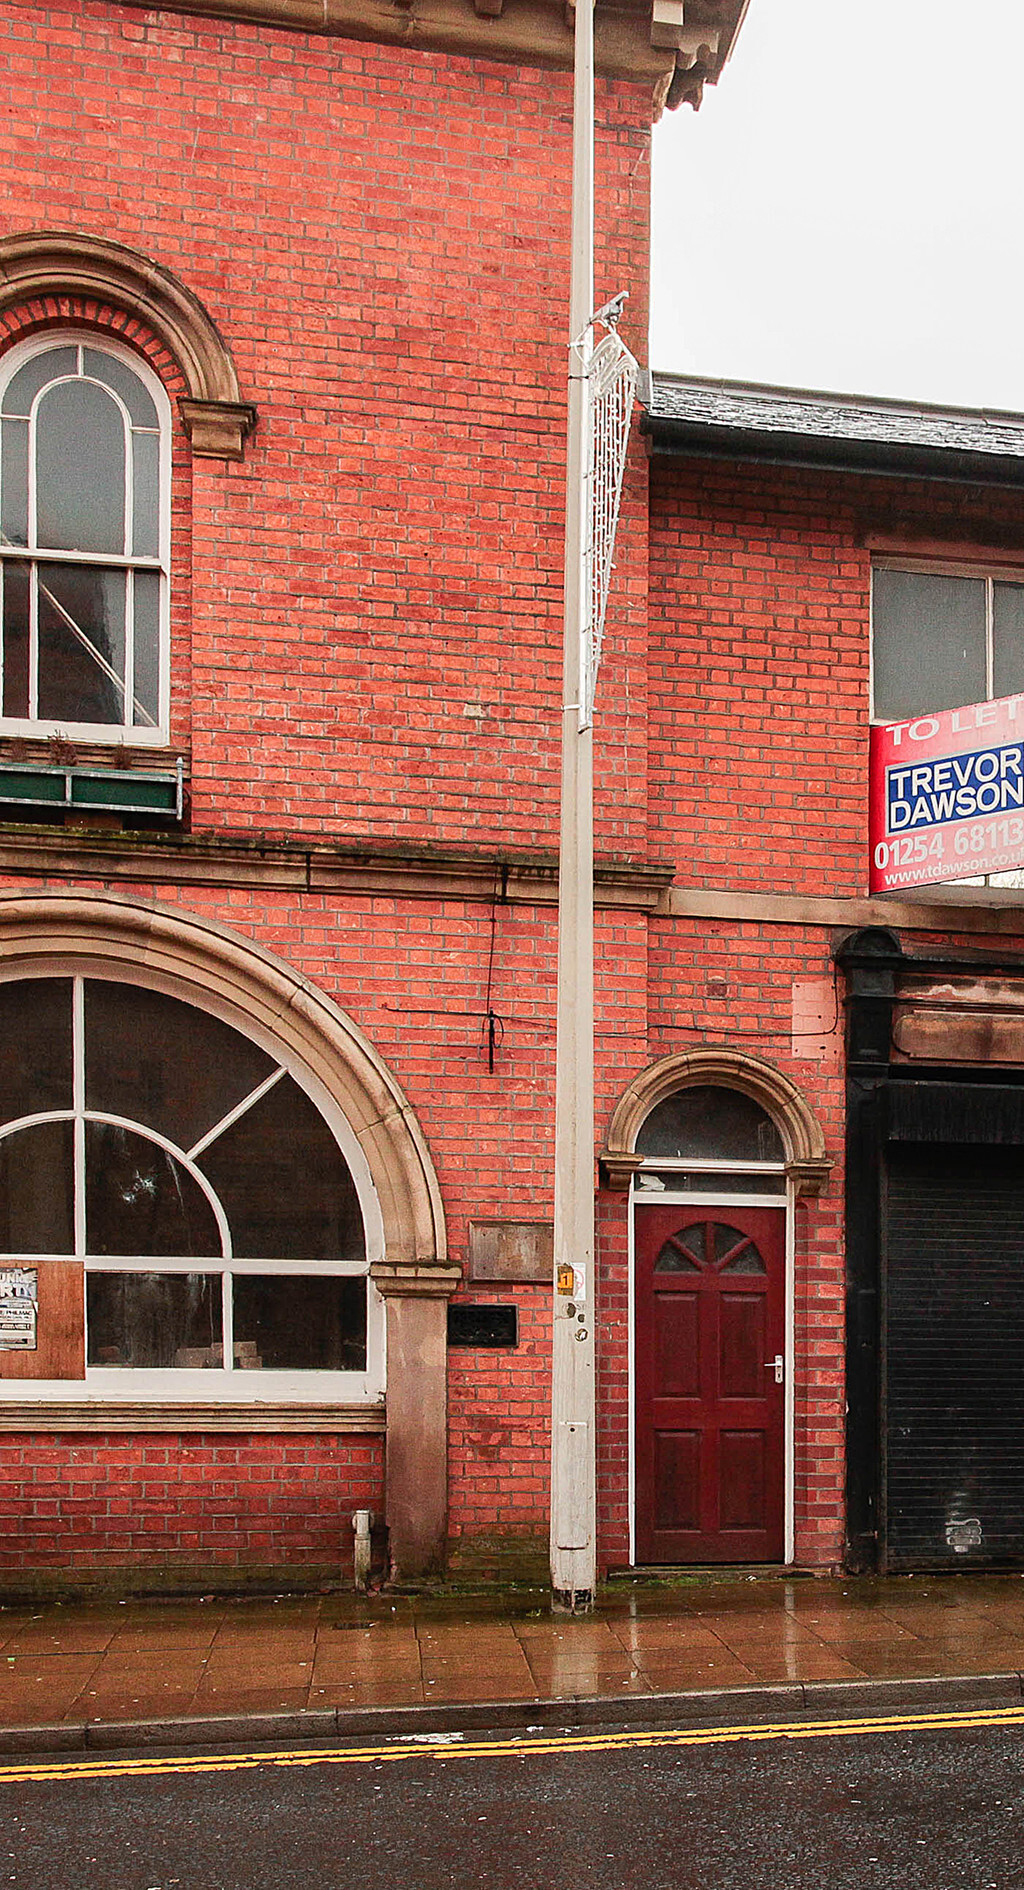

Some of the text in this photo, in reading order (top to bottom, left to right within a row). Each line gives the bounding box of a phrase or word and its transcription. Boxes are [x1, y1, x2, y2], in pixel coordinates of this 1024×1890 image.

[885, 718, 940, 746] TO
[889, 748, 1022, 799] TREVOR
[889, 776, 1024, 830] DAWSON
[874, 832, 945, 870] 01254
